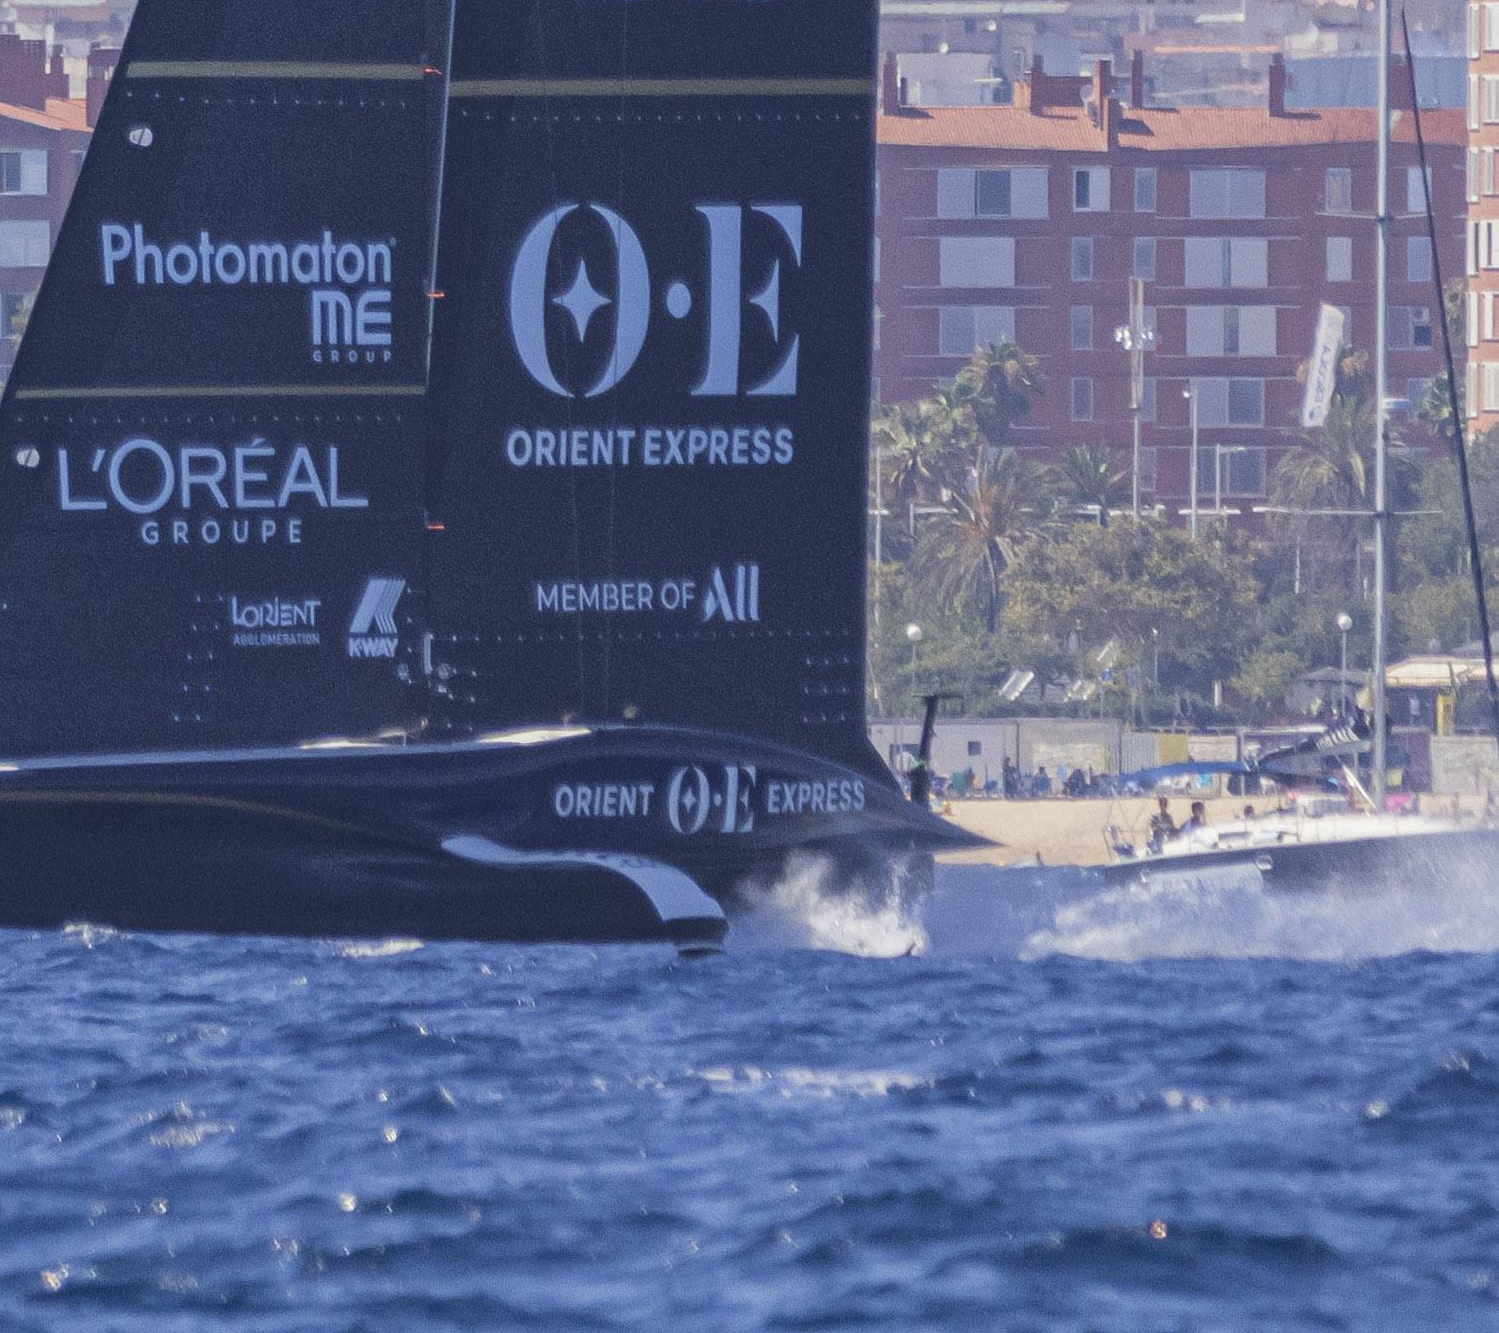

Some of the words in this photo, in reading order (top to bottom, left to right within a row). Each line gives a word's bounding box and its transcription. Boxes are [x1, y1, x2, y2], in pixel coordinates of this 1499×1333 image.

[101, 223, 391, 285] Photomaton
[311, 289, 392, 345] ME
[312, 349, 392, 363] GROUP
[506, 429, 636, 467] ORIENT
[643, 427, 793, 466] EXPRESS
[58, 437, 369, 514] L'ORÉAL
[140, 519, 302, 545] GROUPE
[536, 582, 653, 612] MEMBER
[660, 581, 696, 610] OF
[554, 784, 654, 817] ORIENT
[767, 779, 865, 814] EXPRESS
